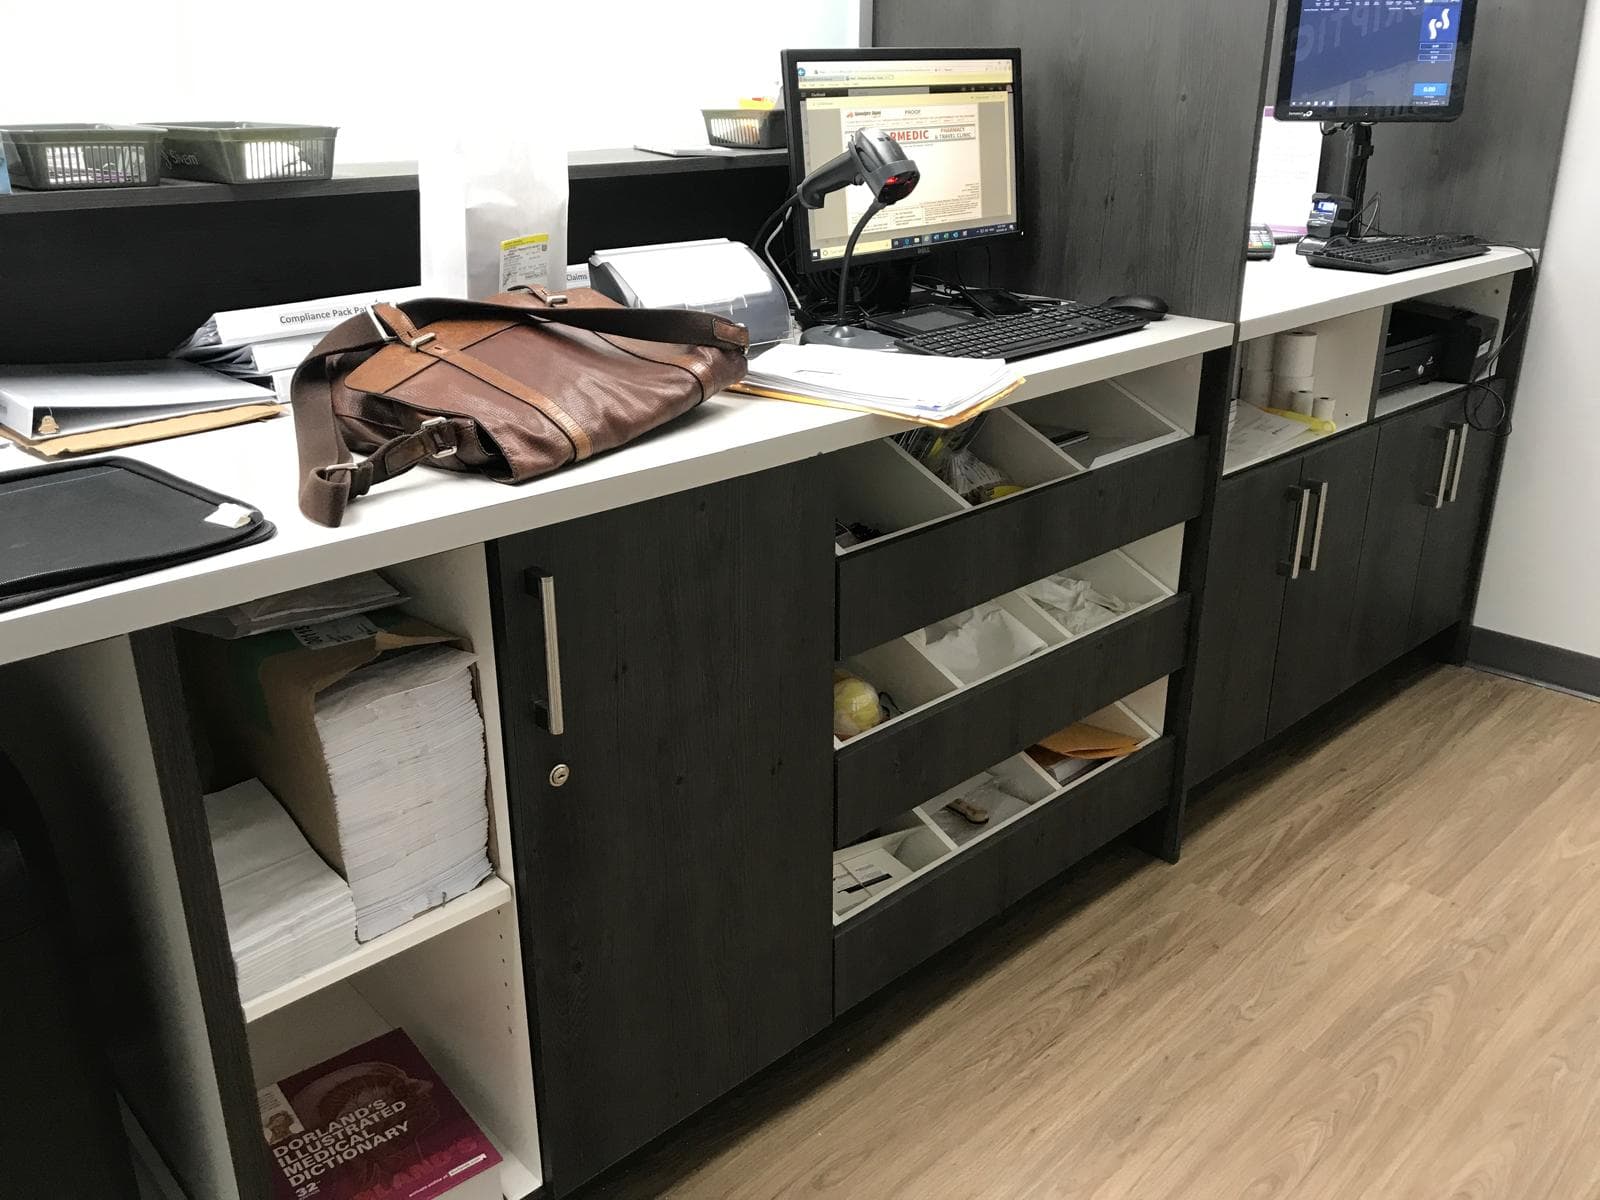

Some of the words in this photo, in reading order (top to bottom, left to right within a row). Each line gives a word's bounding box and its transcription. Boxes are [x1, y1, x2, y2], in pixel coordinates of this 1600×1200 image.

[279, 312, 330, 323] Compliance
[332, 307, 352, 317] Pack
[273, 1099, 386, 1158] DORLAND'S
[278, 1101, 406, 1168] ILLUSTRATED
[283, 1129, 375, 1177] MEDICAL
[289, 1120, 408, 1187] DICTIONARY
